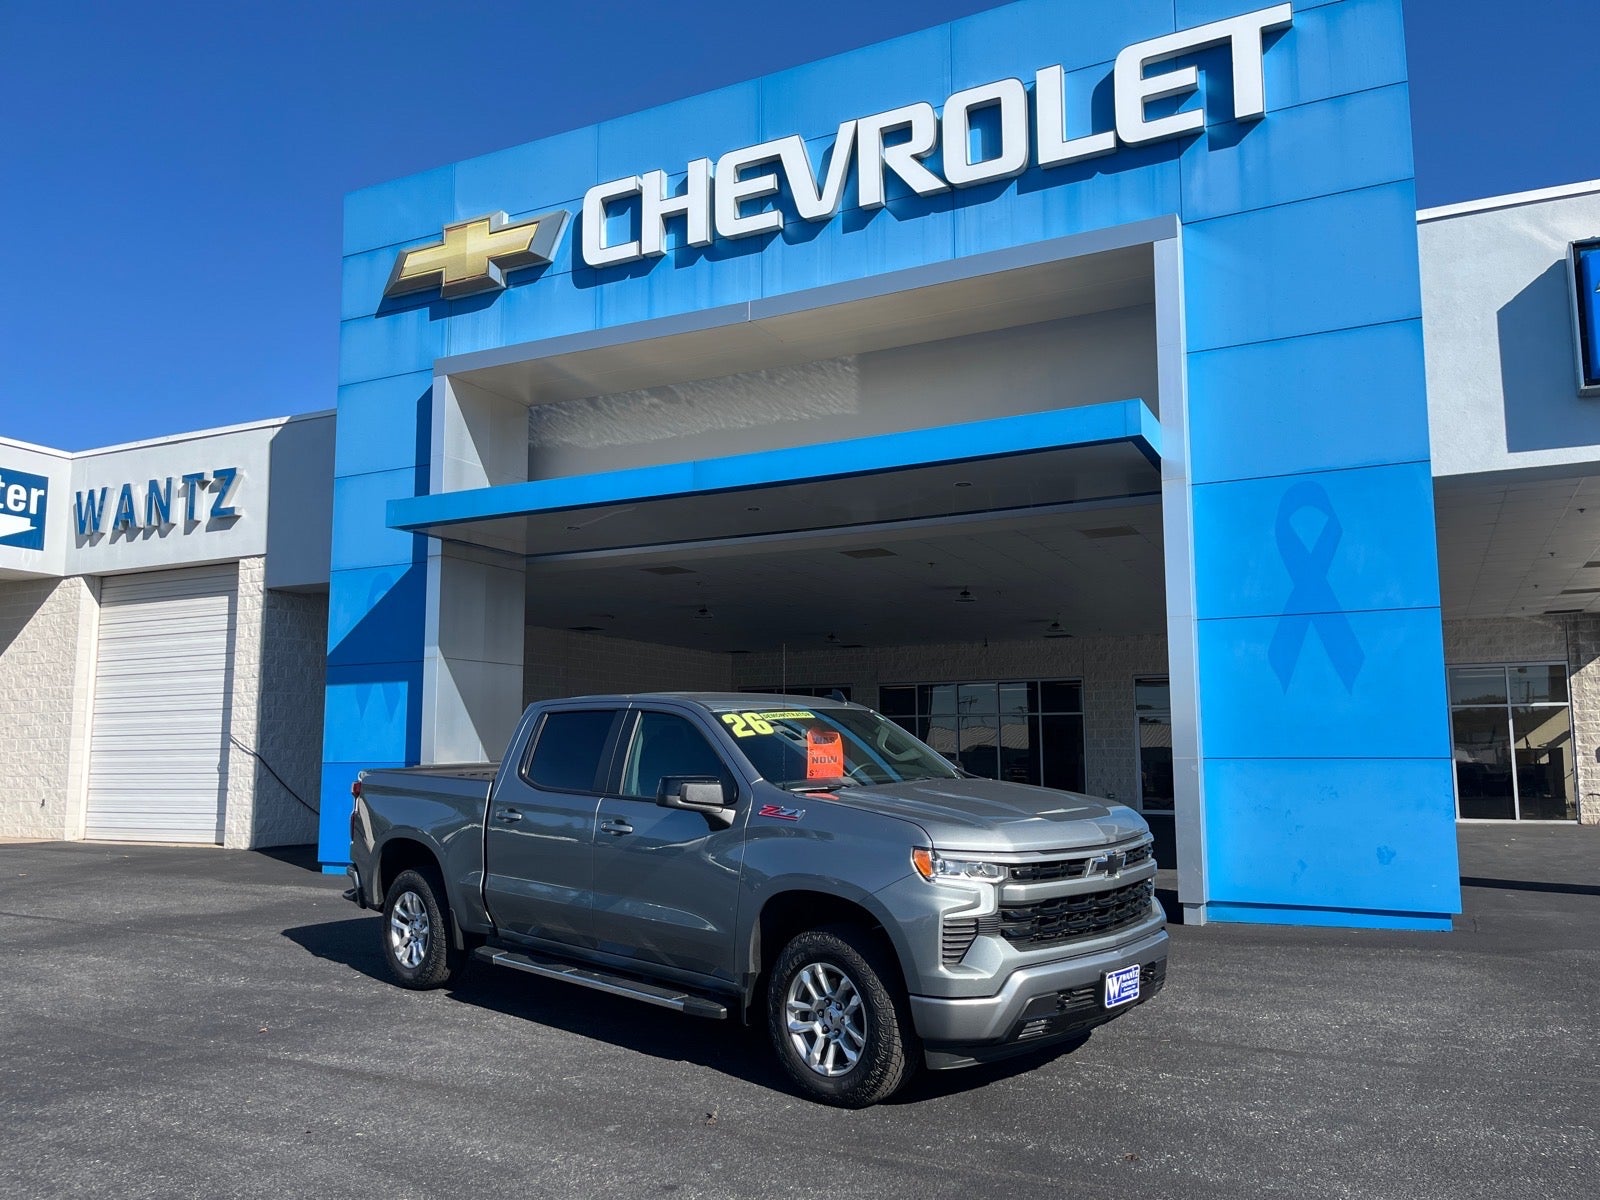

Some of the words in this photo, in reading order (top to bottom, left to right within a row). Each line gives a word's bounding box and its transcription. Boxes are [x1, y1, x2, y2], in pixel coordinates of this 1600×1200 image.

[582, 2, 1293, 267] CHEVROLET
[75, 467, 239, 536] WANTZ
[721, 712, 774, 738] 26
[812, 755, 837, 764] NOW
